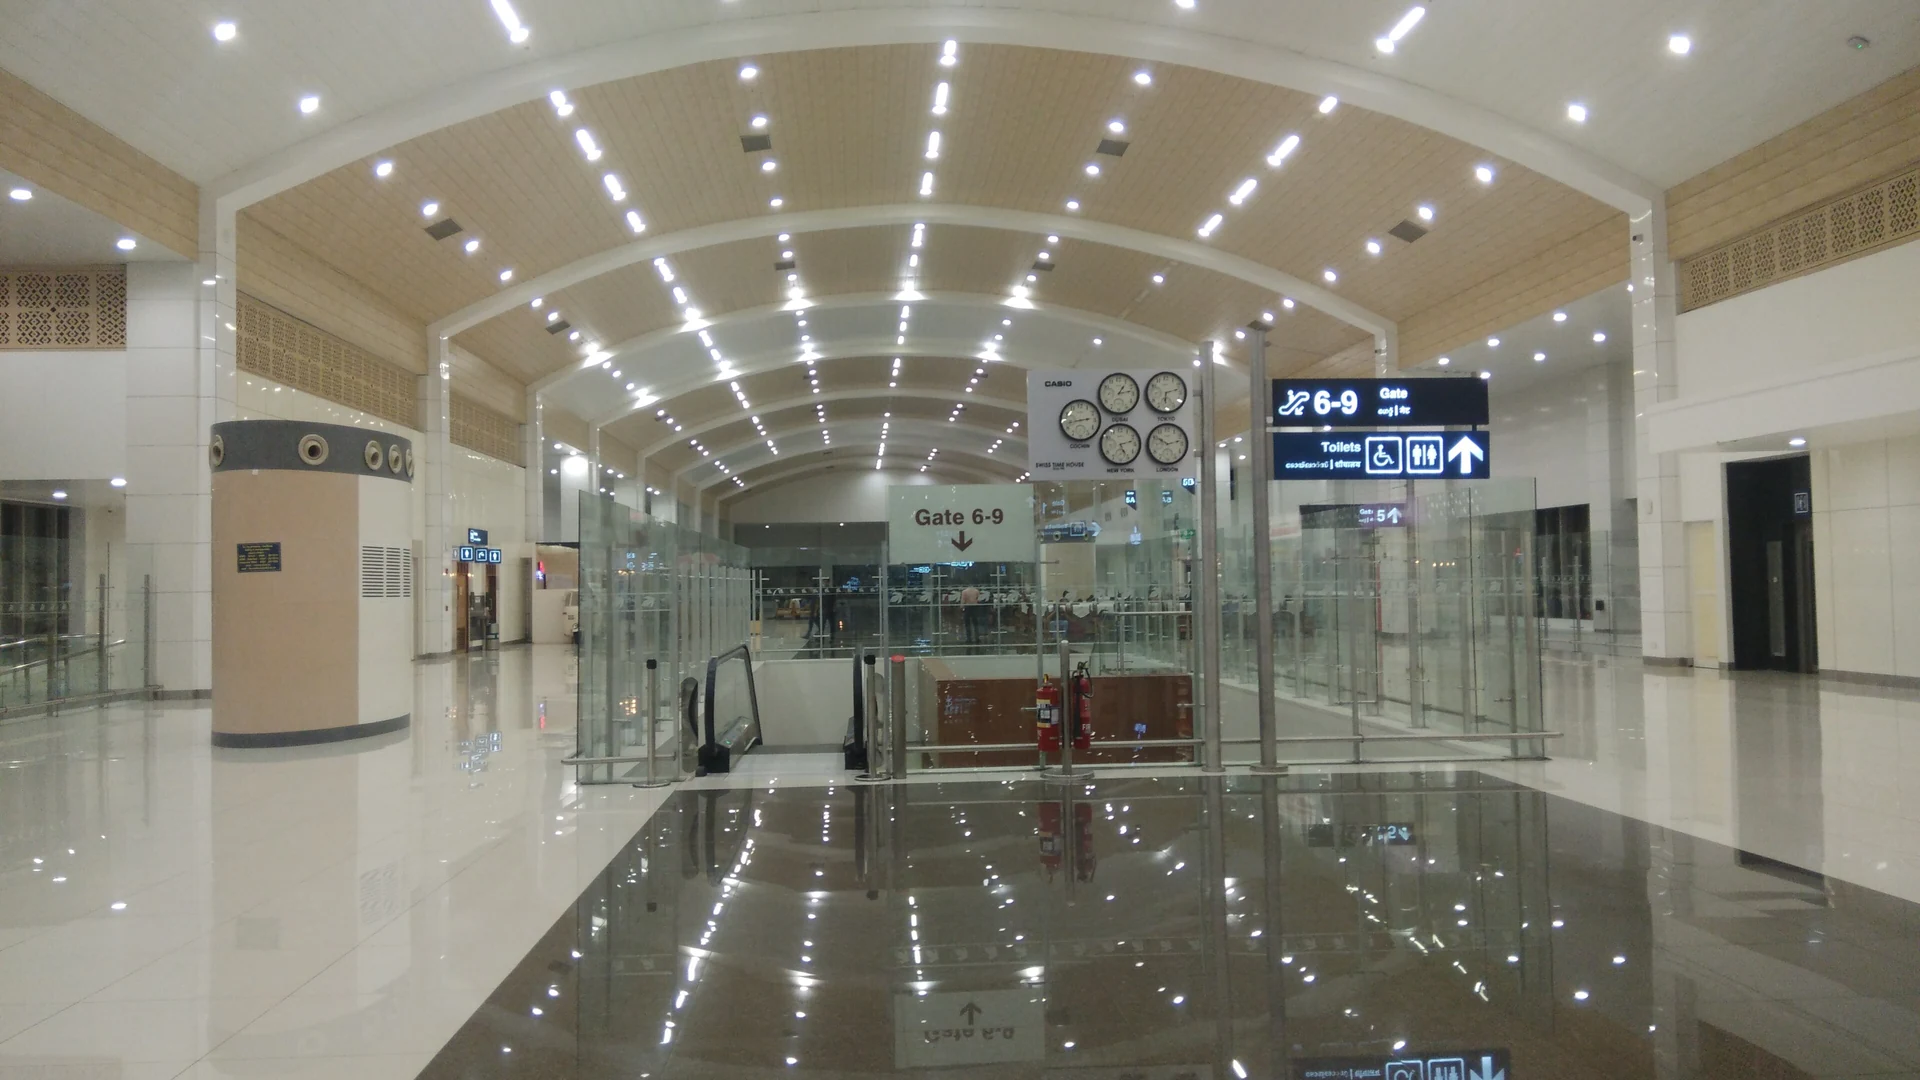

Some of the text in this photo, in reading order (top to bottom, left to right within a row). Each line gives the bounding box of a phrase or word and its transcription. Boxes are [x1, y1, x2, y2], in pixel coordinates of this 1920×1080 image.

[1380, 387, 1408, 399] Gate
[1314, 390, 1358, 415] 6-9
[1321, 441, 1361, 453] Toilets
[915, 508, 1004, 526] Gate 6-9
[1377, 509, 1386, 522] 5
